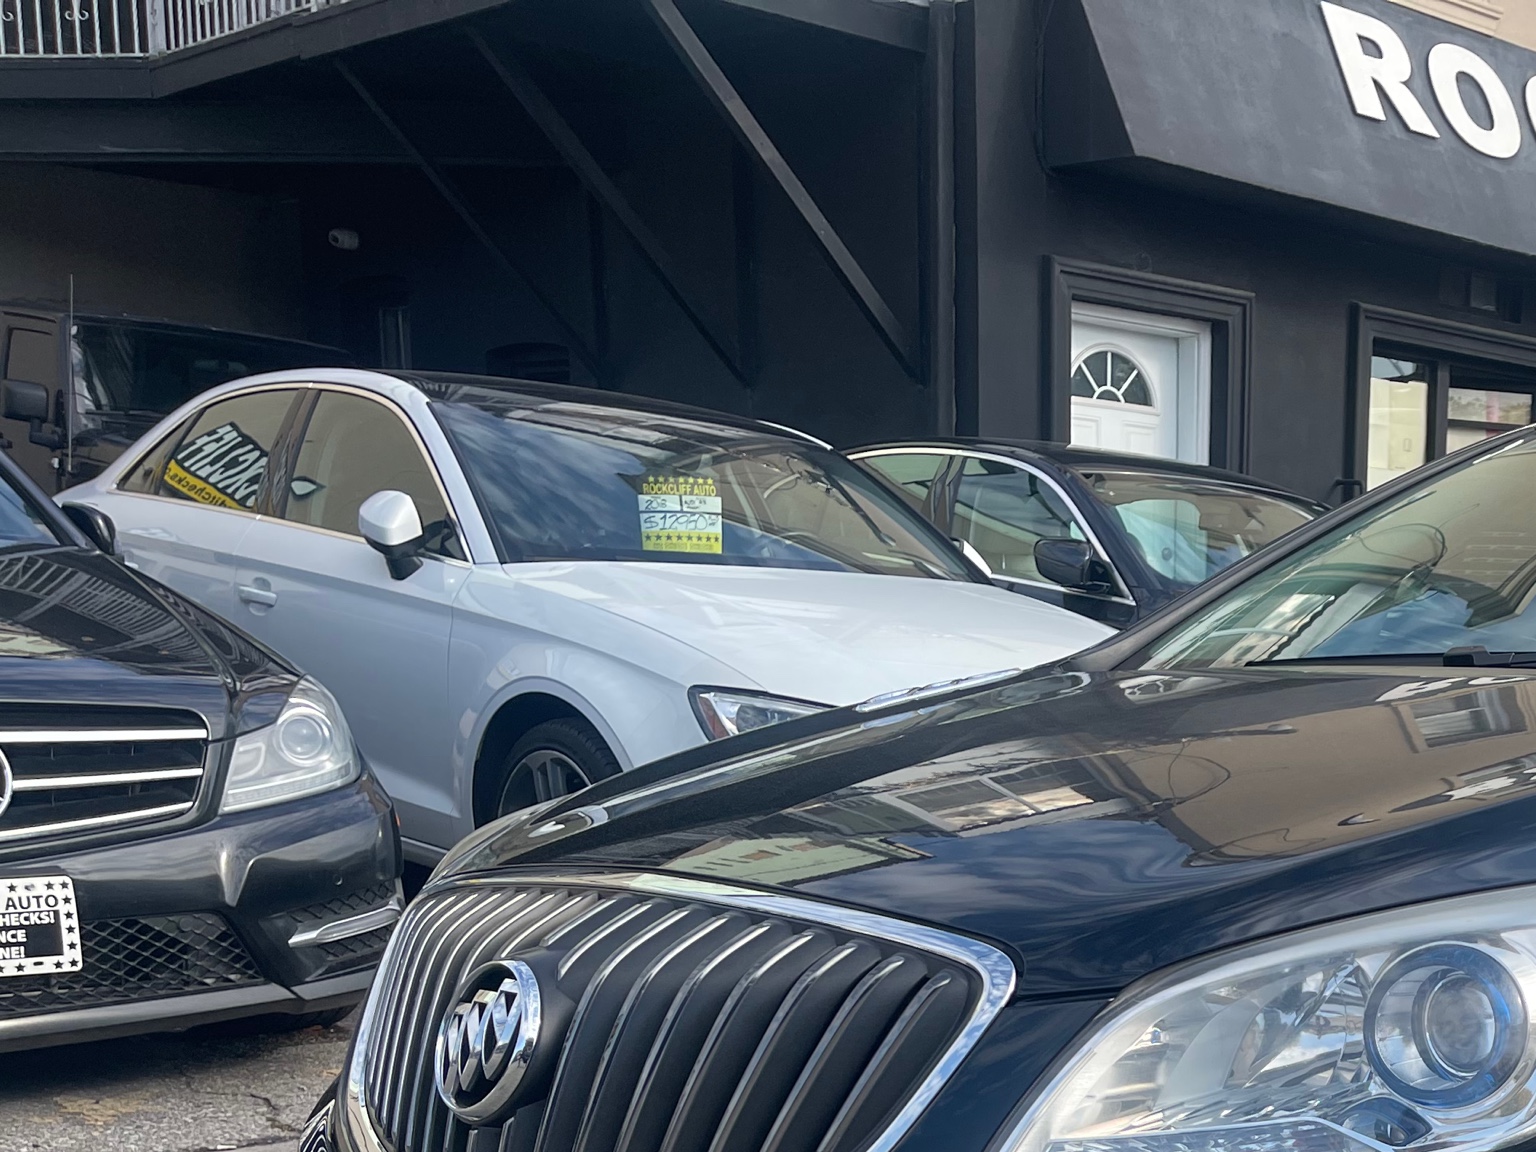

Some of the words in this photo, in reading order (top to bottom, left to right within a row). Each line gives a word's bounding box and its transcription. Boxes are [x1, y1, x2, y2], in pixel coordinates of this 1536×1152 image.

[643, 483, 691, 495] ROCKCLIFF
[694, 484, 717, 496] AUTO
[5, 894, 59, 911] AUTO
